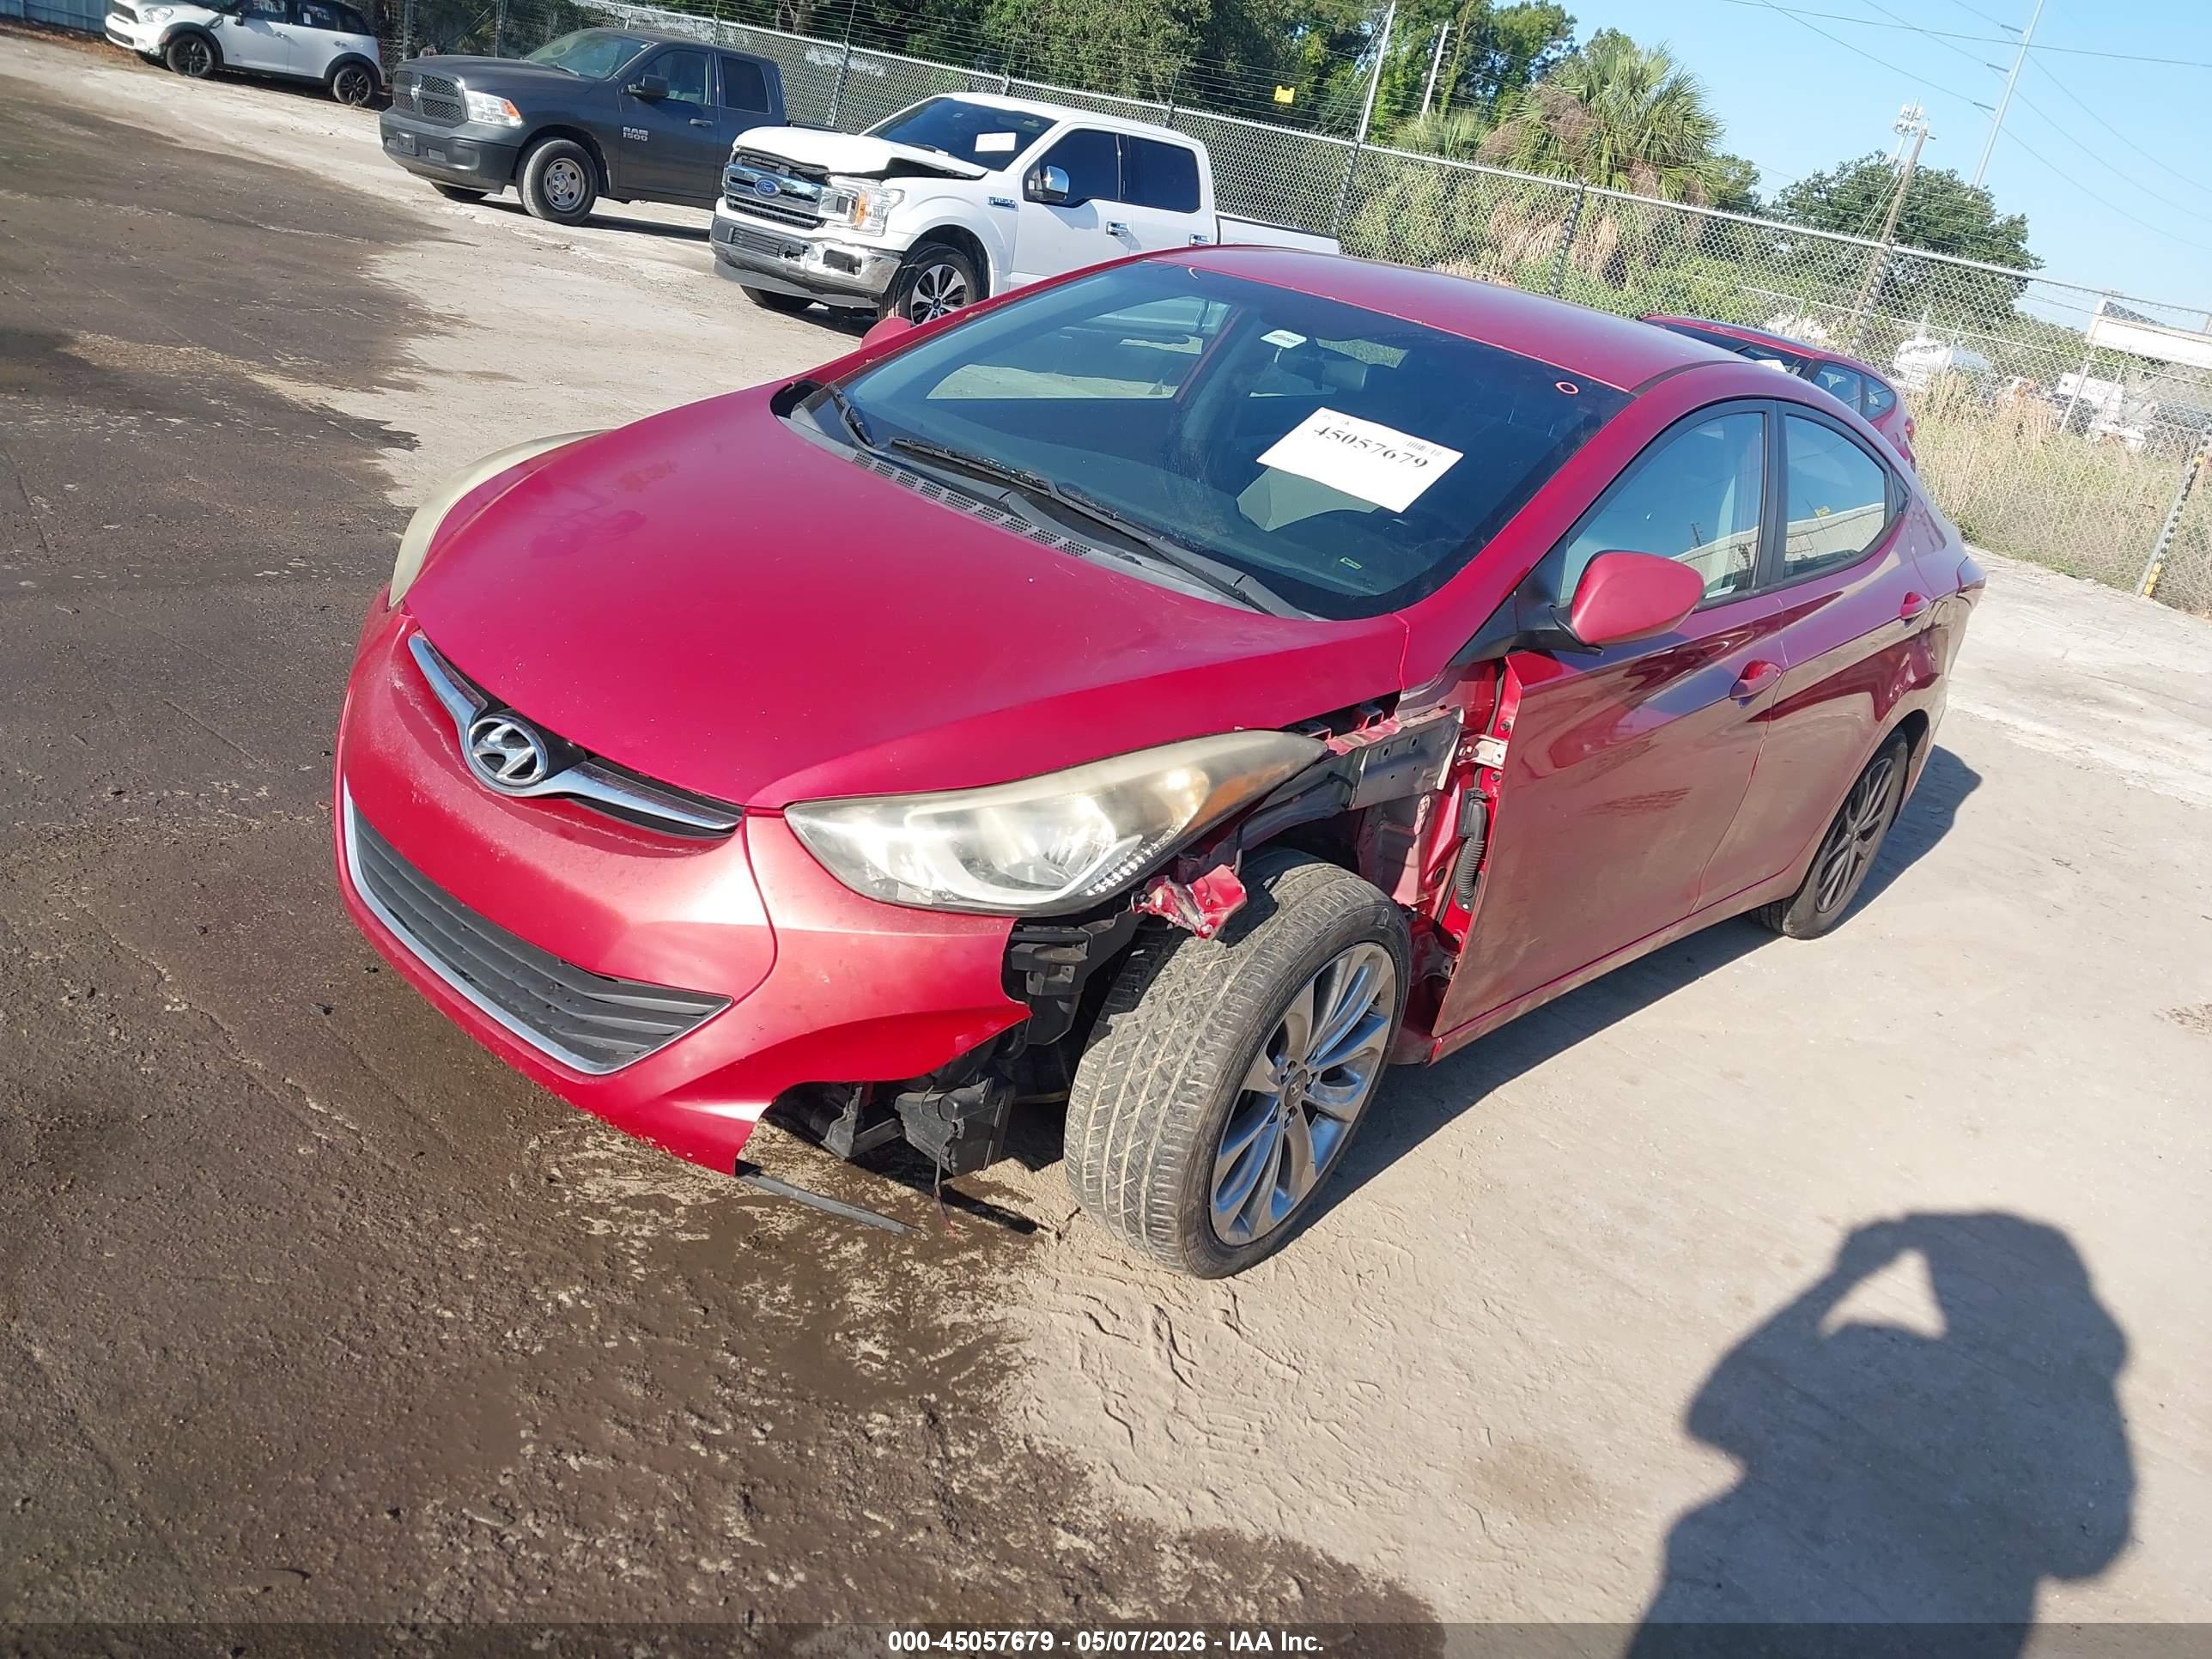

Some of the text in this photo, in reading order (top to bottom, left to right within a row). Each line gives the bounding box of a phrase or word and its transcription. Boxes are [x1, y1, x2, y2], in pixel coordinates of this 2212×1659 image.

[623, 126, 648, 136] RAM
[623, 131, 648, 142] 1500
[1313, 426, 1429, 468] 45057679
